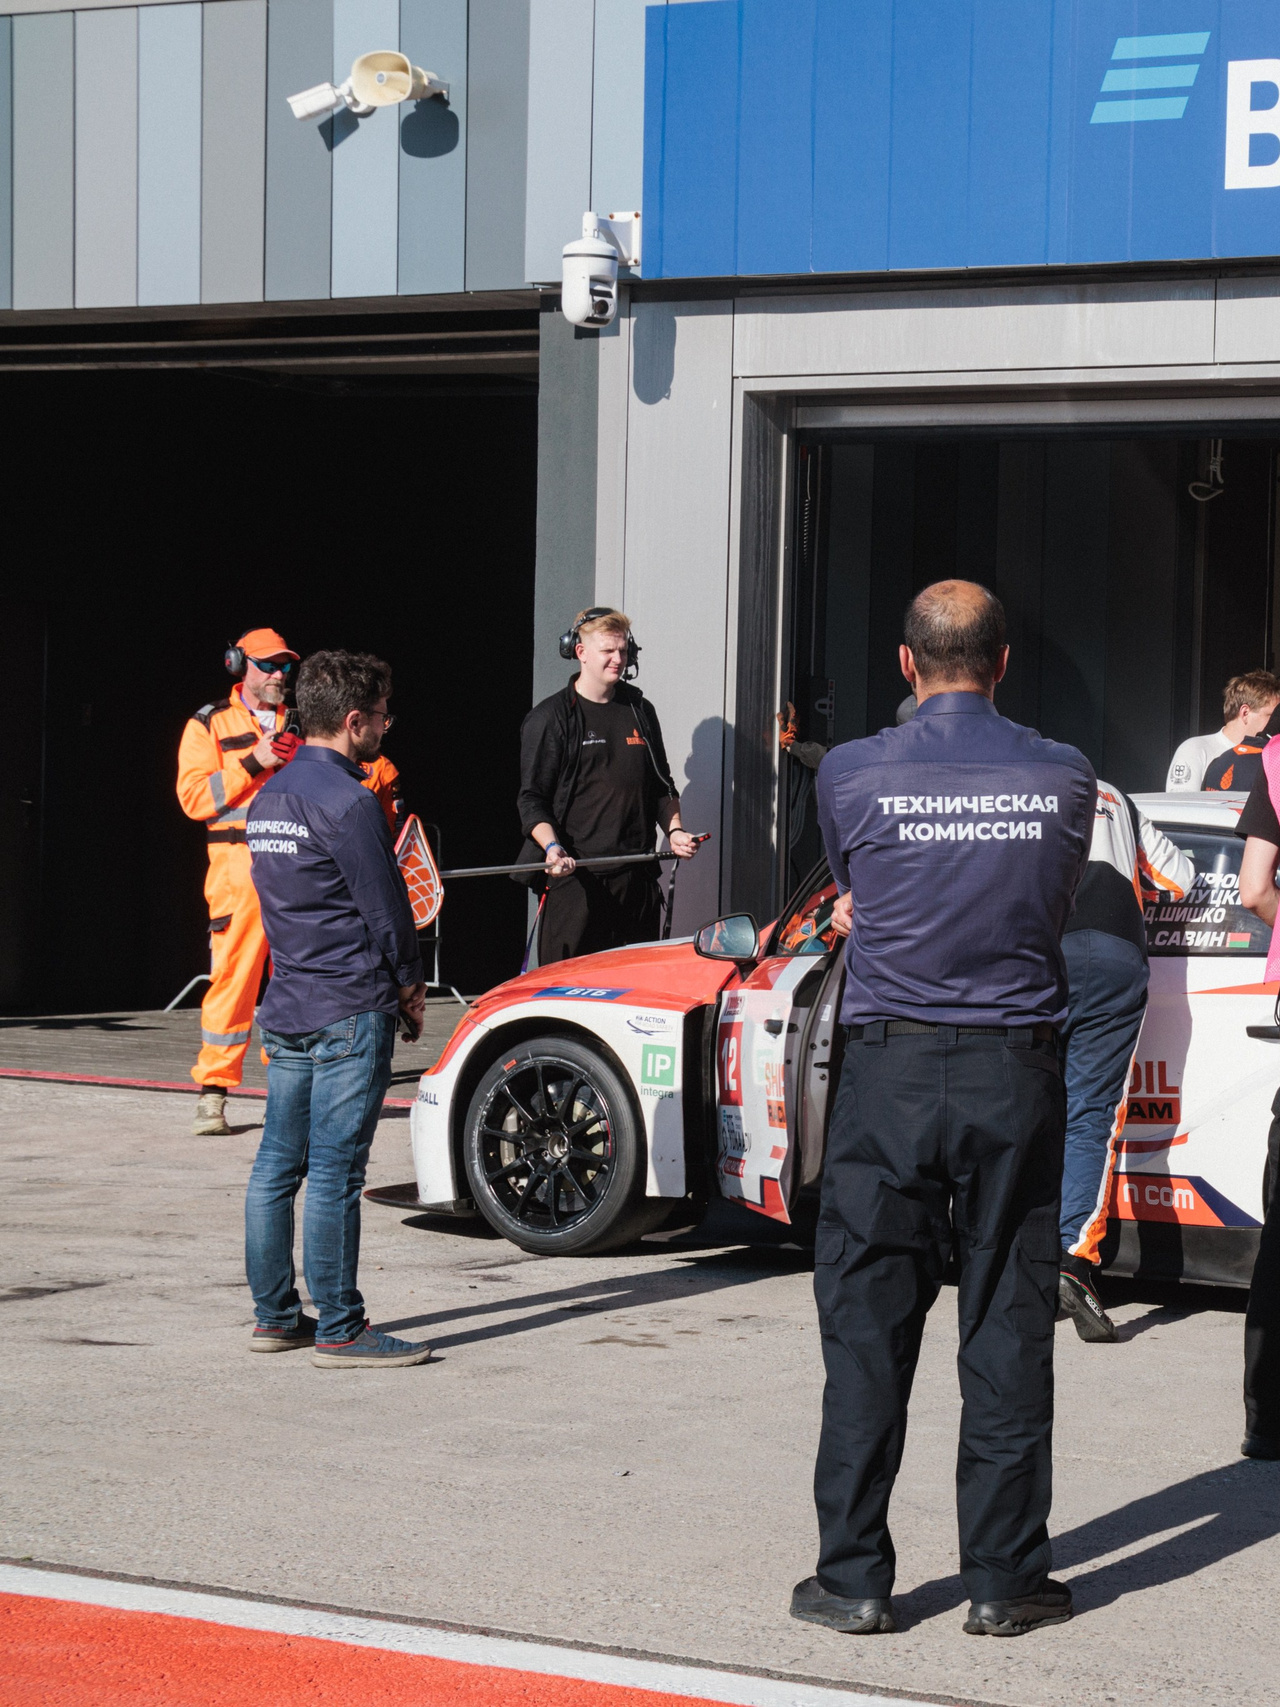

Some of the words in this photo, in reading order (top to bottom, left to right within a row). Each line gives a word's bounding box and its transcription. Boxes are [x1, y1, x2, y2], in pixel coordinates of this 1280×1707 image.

[878, 794, 1058, 815] ТЕХНИЧЕСКАЯ
[246, 820, 309, 838] ЕХНИЧЕСКАЯ
[899, 821, 1042, 841] КОМИССИЯ
[1145, 906, 1226, 924] Д.ШИШКО
[1145, 930, 1225, 947] .САВИН
[565, 988, 612, 996] ВТБ
[644, 1016, 666, 1024] ACTION
[646, 1053, 671, 1078] IP
[722, 1037, 737, 1091] 12
[641, 1086, 674, 1100] integra
